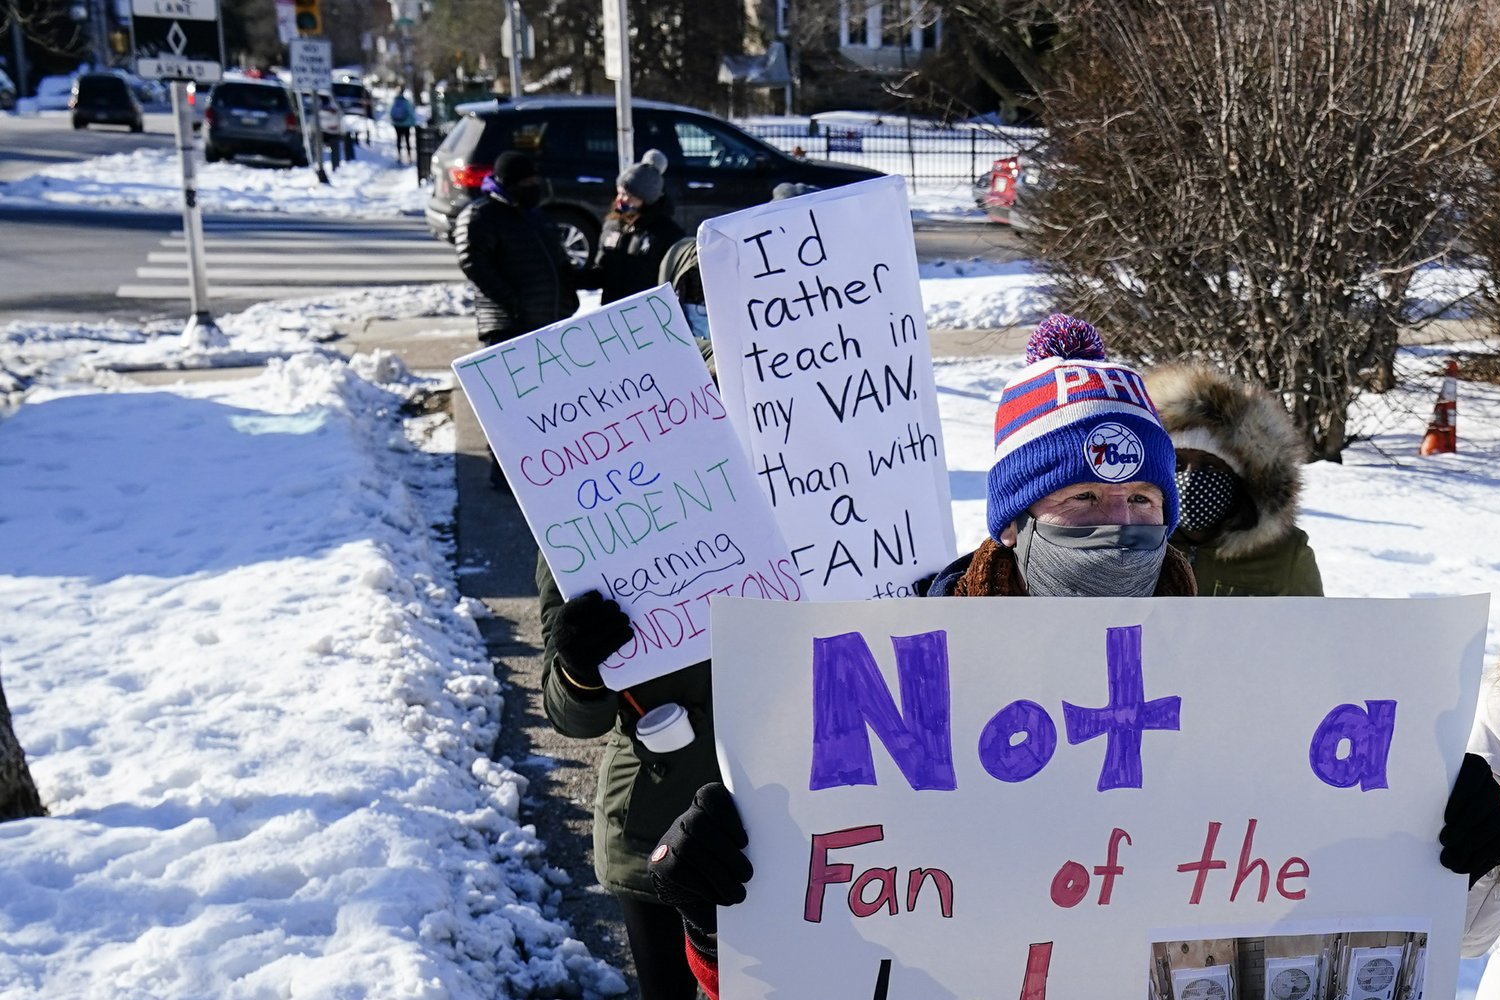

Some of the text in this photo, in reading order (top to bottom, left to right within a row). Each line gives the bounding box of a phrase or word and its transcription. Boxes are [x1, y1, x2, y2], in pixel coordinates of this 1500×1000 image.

[743, 209, 828, 279] I'd
[747, 263, 890, 332] rather
[460, 294, 691, 411] TEACHER
[744, 312, 918, 382] teach in
[519, 383, 728, 487] CONDITIONS
[526, 372, 669, 434] working
[752, 396, 794, 445] my
[577, 460, 661, 510] are
[757, 422, 939, 508] than with
[1090, 442, 1140, 467] 76ers
[544, 458, 738, 574] STUDENT
[830, 494, 868, 526] a
[600, 532, 747, 600] learning
[790, 509, 918, 587] FAN!
[808, 623, 1399, 792] Not a
[802, 817, 1311, 925] Fan of the
